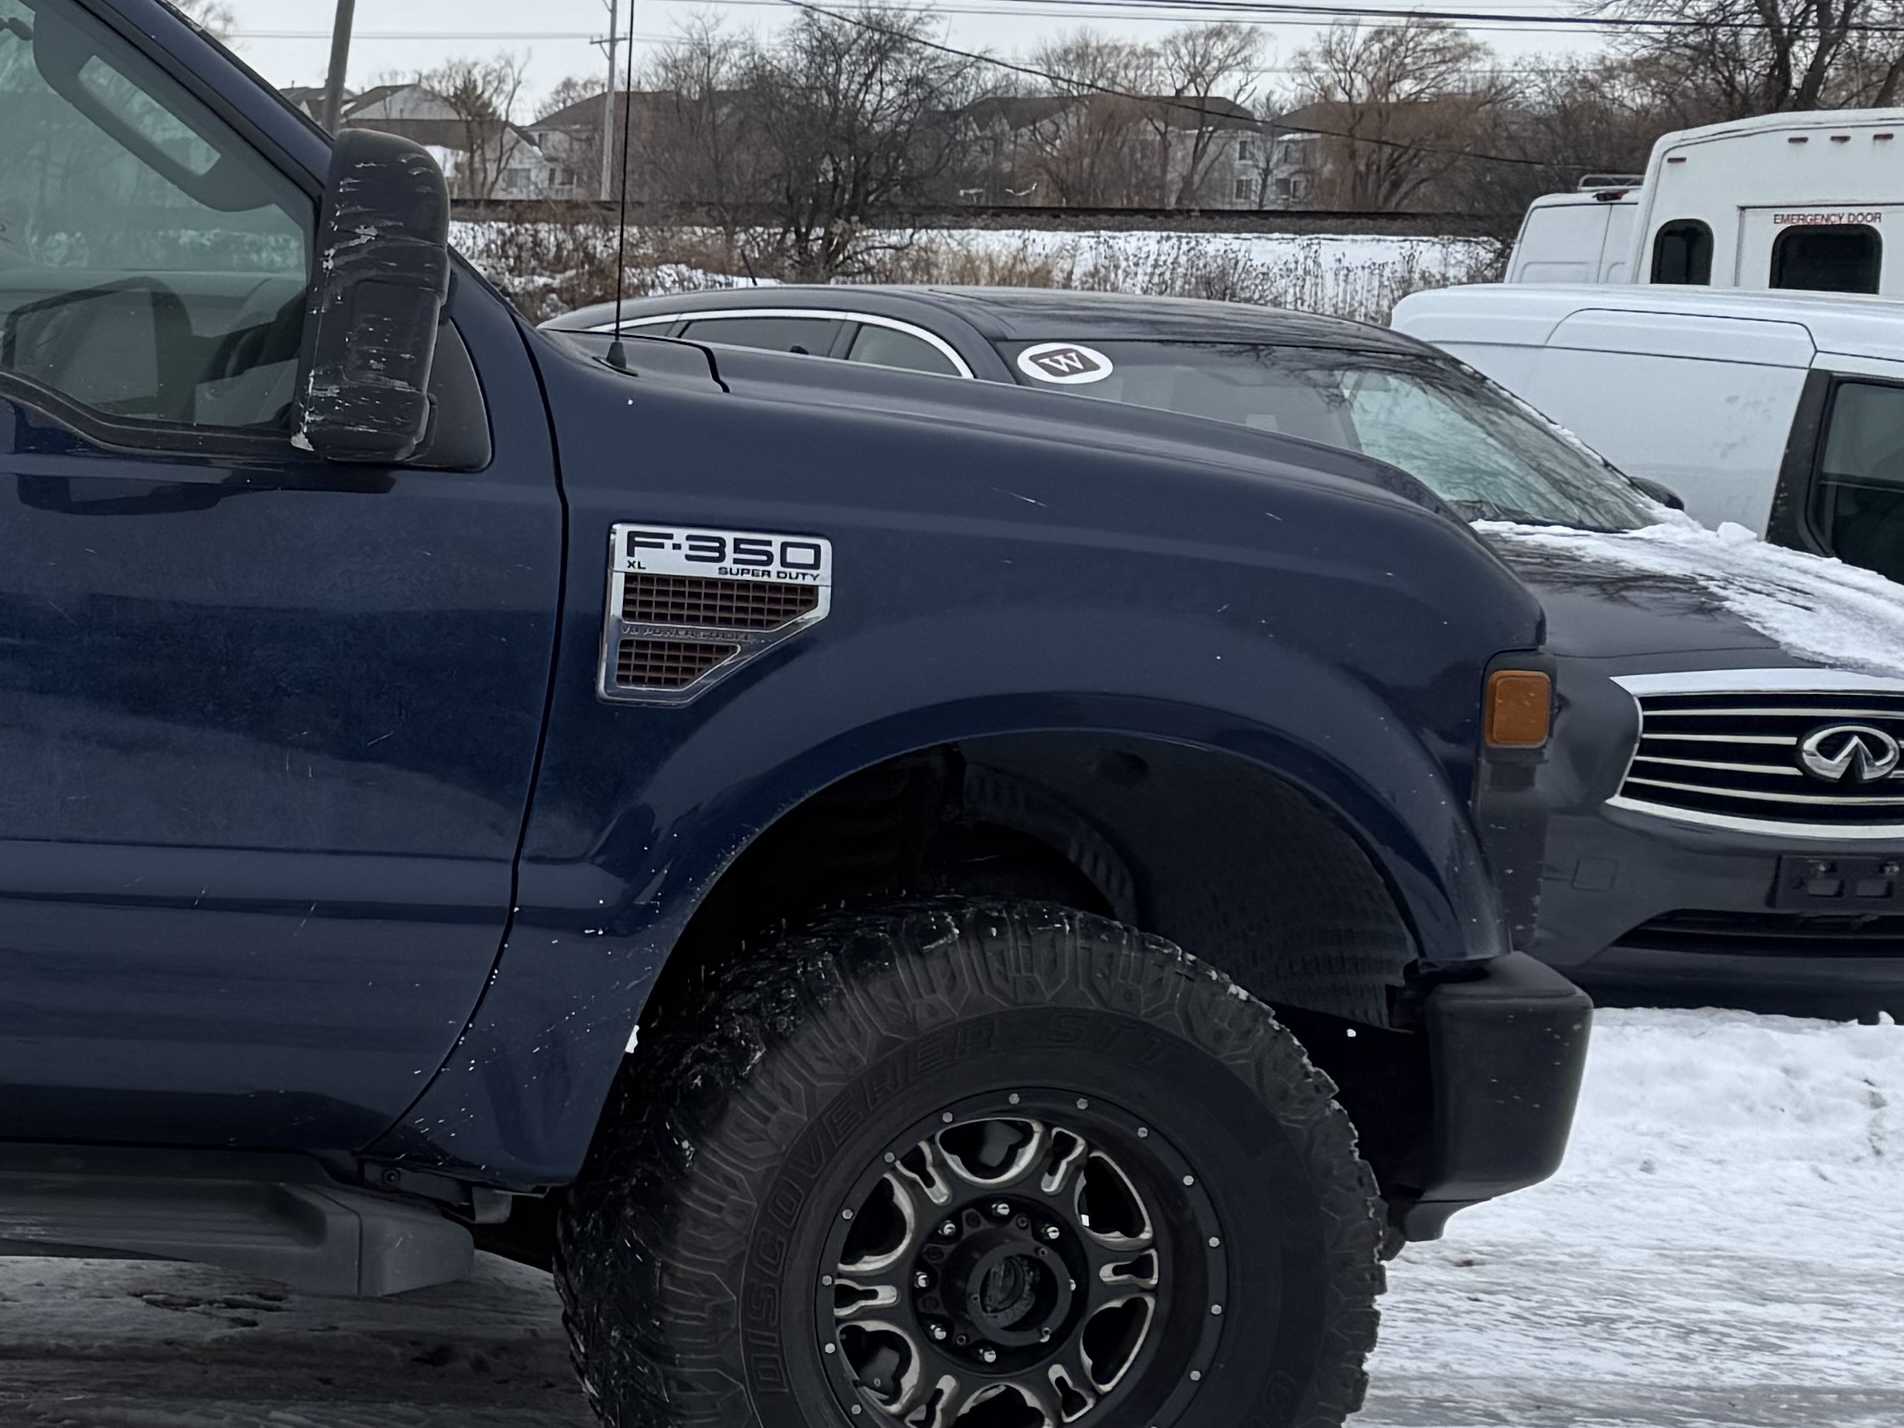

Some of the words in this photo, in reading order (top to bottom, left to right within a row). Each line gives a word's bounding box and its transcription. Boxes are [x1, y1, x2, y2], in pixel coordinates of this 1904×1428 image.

[1773, 213, 1844, 224] EMERGENCY
[1847, 212, 1882, 223] DOOR
[1038, 352, 1084, 373] W
[626, 530, 822, 570] F-350
[627, 559, 647, 570] XL
[718, 566, 772, 579] SUPER
[776, 570, 821, 582] DUTY
[743, 1020, 995, 1395] DISCOVERER
